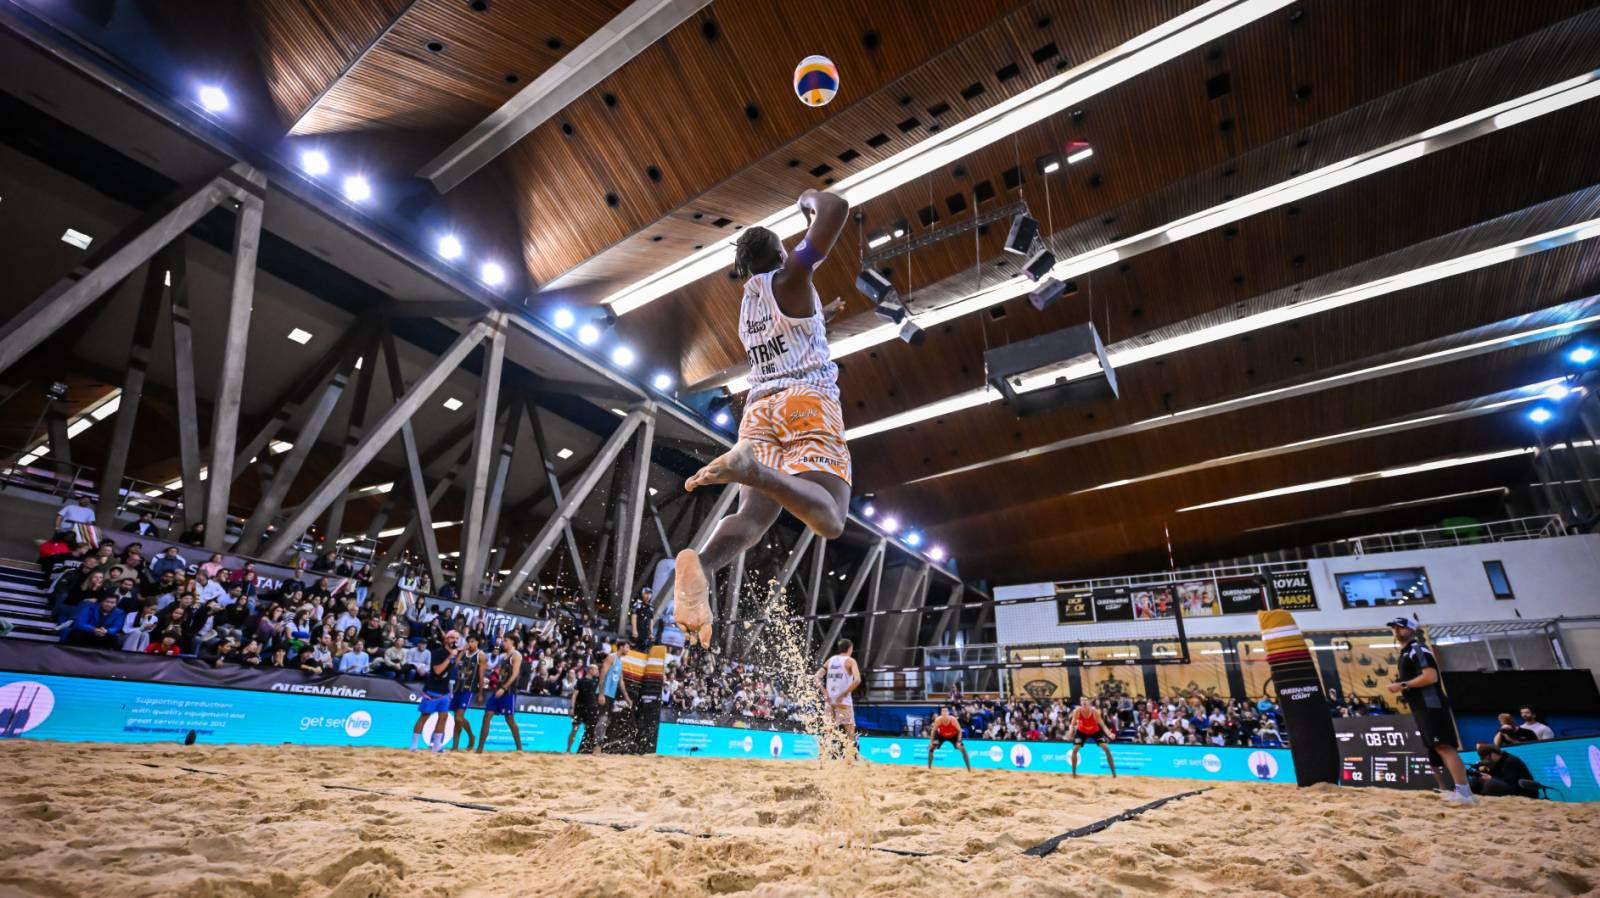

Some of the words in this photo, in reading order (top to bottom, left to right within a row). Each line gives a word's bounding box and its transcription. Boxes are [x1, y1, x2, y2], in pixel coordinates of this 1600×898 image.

[761, 363, 776, 375] ENG
[1277, 594, 1312, 605] MASH
[154, 719, 184, 727] service
[299, 716, 324, 731] get
[325, 717, 346, 729] set
[347, 716, 370, 730] hire
[1364, 732, 1405, 747] 08:07
[1352, 772, 1363, 781] 02
[1385, 773, 1397, 782] 02
